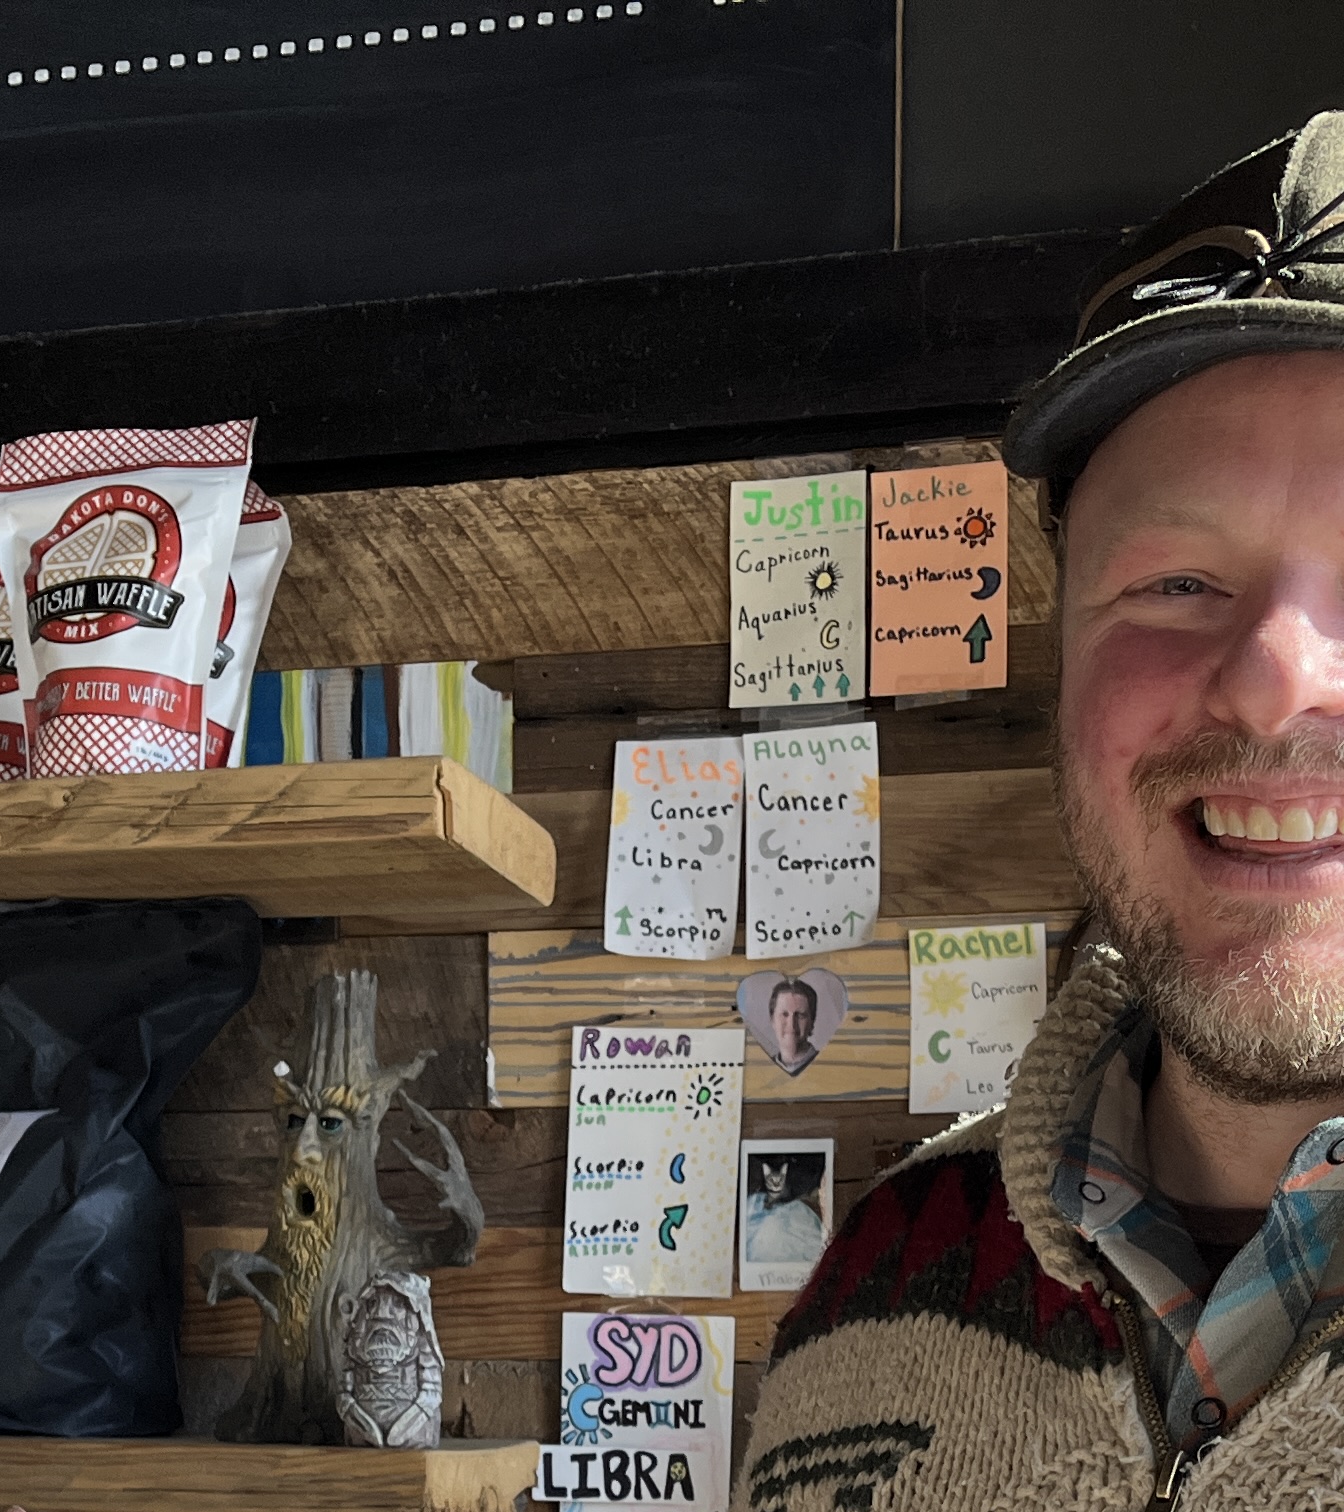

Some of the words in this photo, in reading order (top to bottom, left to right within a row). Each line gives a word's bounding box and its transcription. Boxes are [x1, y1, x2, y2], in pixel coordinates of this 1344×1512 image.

[742, 480, 864, 531] Justin
[882, 476, 973, 508] Jackie
[47, 491, 114, 543] DAKOTA
[874, 520, 950, 542] Taurus
[735, 545, 830, 582] Capricorn
[875, 566, 974, 591] Sagittarius
[97, 581, 175, 621] WAFFLE
[63, 621, 99, 639] MIX
[738, 601, 818, 640] Aquarius
[875, 624, 961, 645] Capricorn
[733, 653, 845, 693] Sagittarius
[75, 681, 121, 702] BETTER
[127, 683, 177, 714] WAFFLE
[753, 735, 872, 766] Alayna
[631, 747, 742, 786] Elias
[650, 800, 735, 821] Cancer
[758, 785, 849, 813] Cancer
[631, 846, 703, 872] Libra
[777, 855, 876, 875] Capricorn
[639, 917, 722, 943] Scorpio
[754, 921, 843, 943] Scorpio
[913, 925, 1036, 965] Rachel
[971, 979, 1040, 1001] Capricorn
[579, 1028, 692, 1061] Rowan
[966, 1038, 1015, 1057] Taurus
[576, 1084, 677, 1106] Capricorn
[966, 1078, 995, 1095] Leo
[573, 1156, 645, 1177] Scorpio
[569, 1219, 640, 1240] Scorpio
[593, 1316, 703, 1388] SYD
[598, 1398, 706, 1429] GEMINI
[542, 1449, 696, 1501] LIBRA
